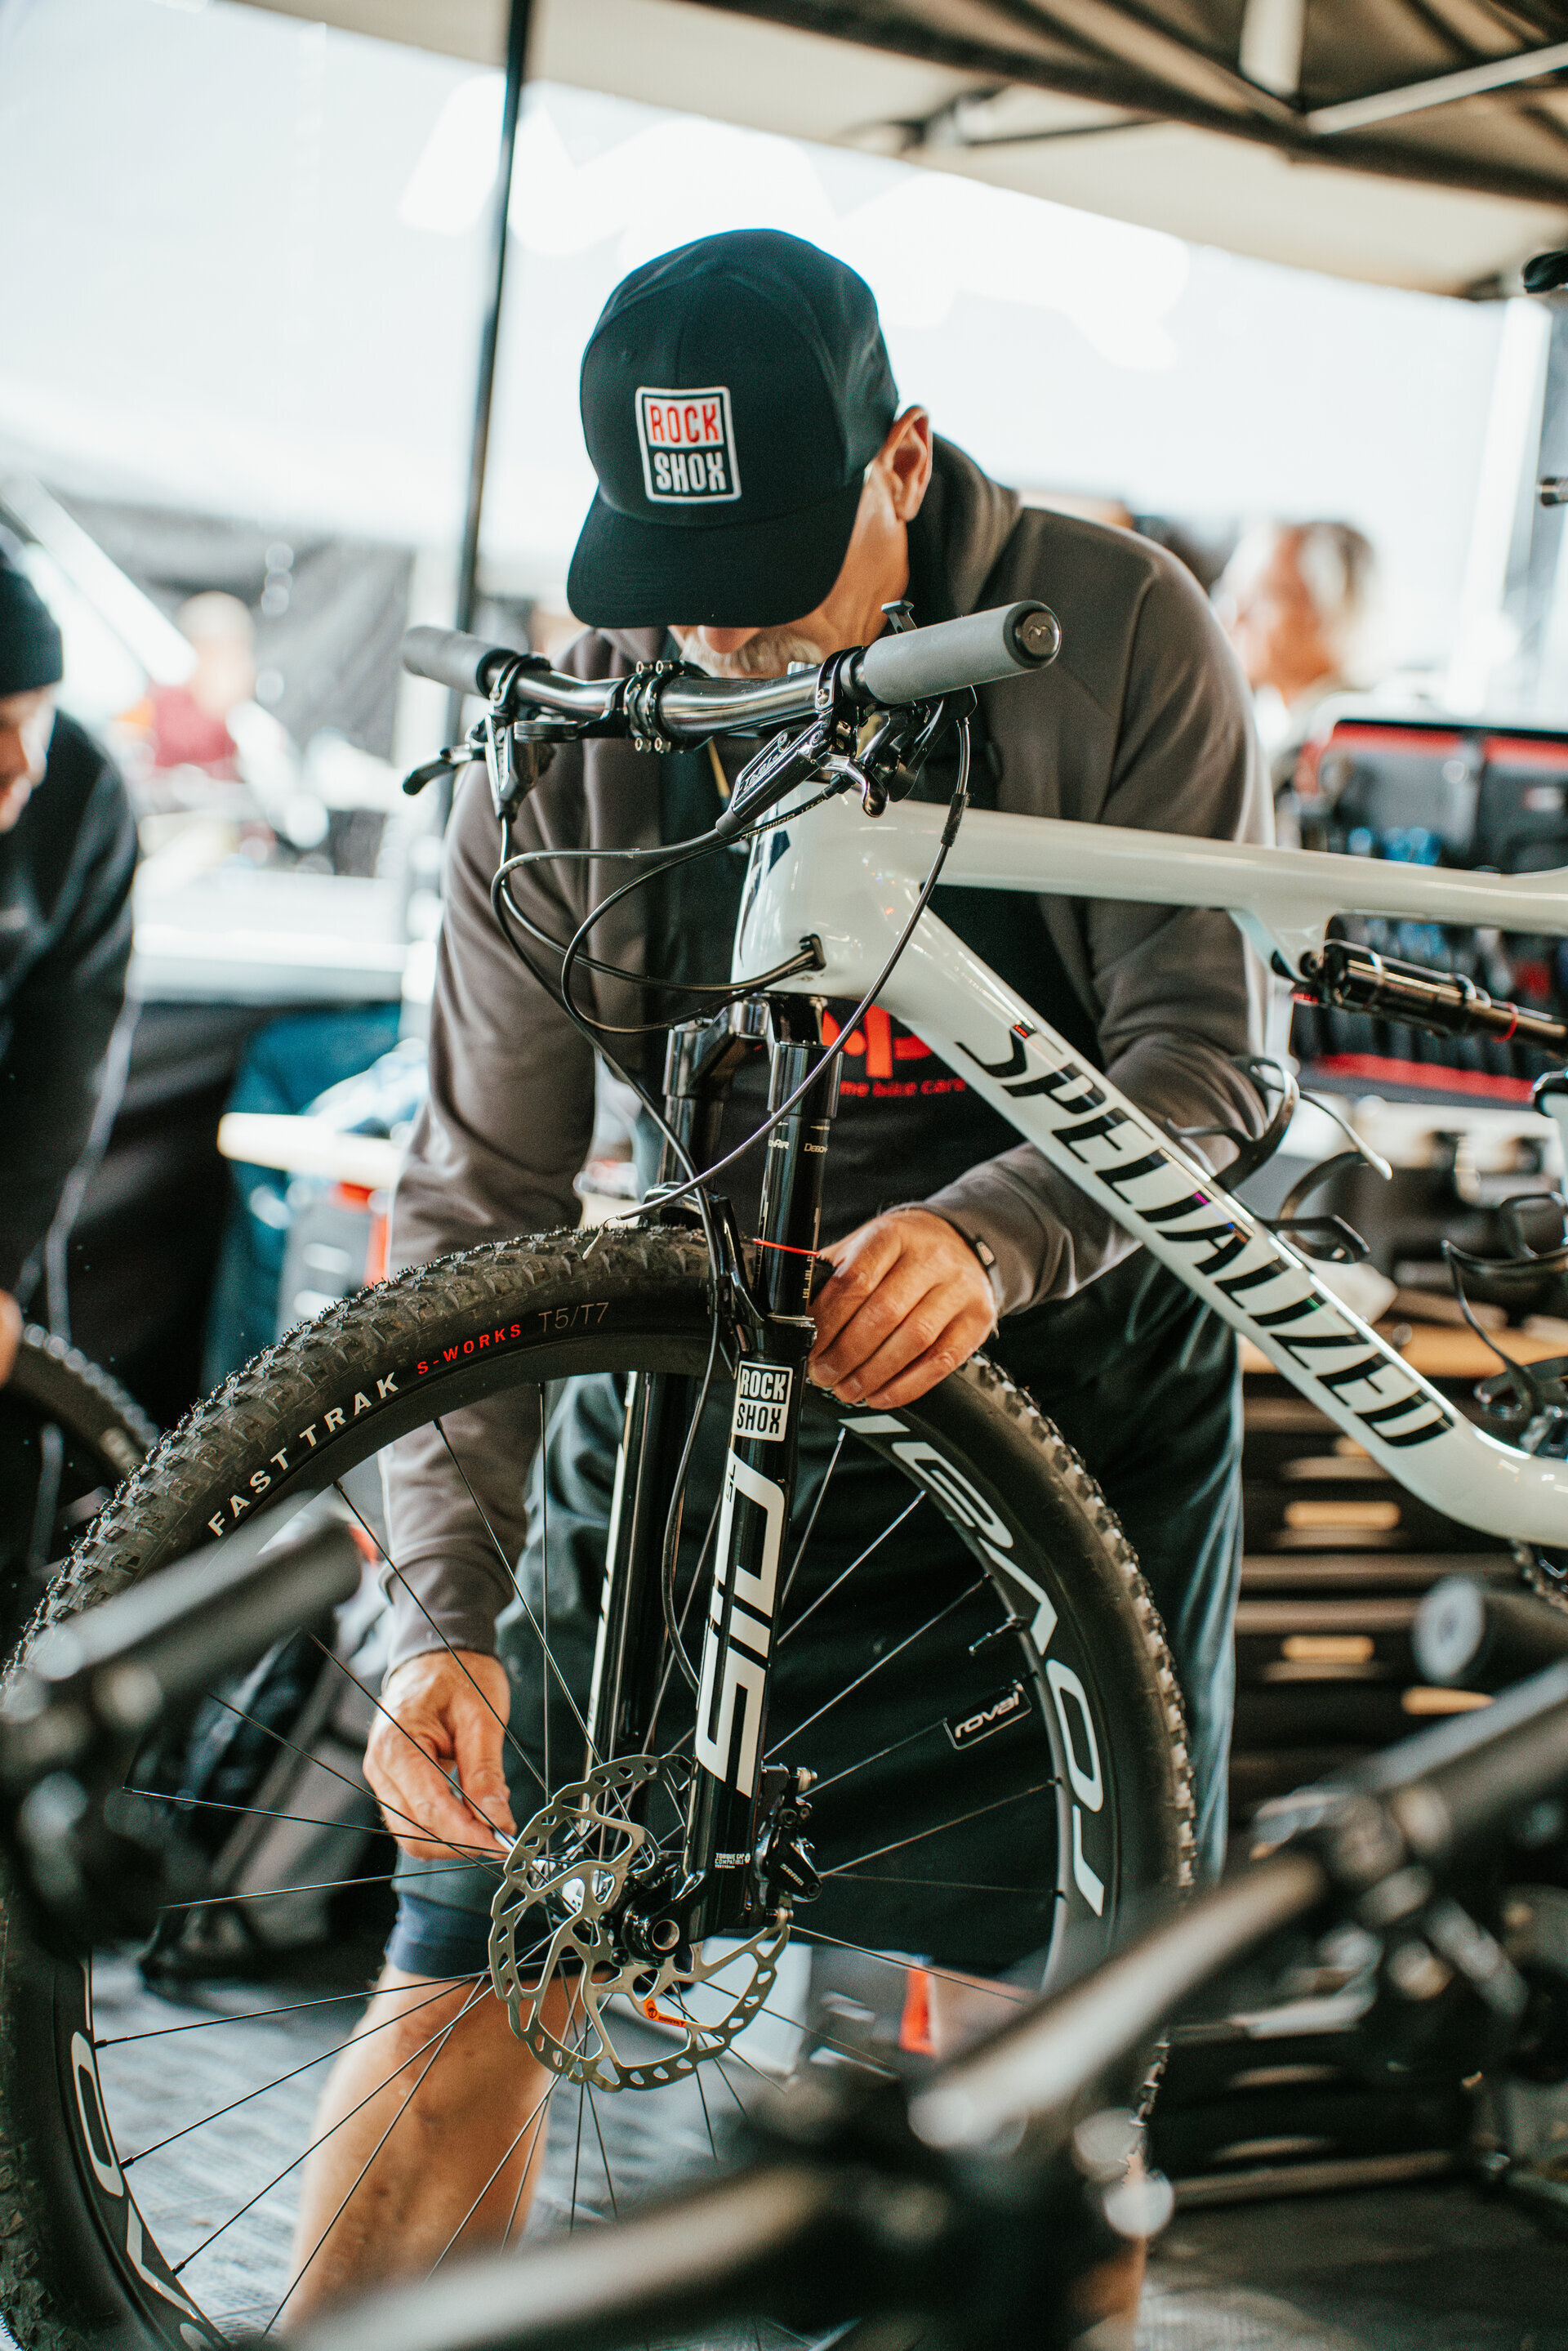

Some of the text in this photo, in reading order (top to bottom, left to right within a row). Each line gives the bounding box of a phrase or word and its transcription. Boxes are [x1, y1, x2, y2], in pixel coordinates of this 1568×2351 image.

[650, 404, 719, 444] ROCK
[653, 451, 727, 493] SHOX
[955, 1025, 1456, 1448] SPECIALIZED
[738, 1367, 788, 1403] ROCK
[207, 1302, 609, 1537] FAST TRAK S-WORKS T5/T7
[737, 1402, 782, 1435] SHOX
[695, 1447, 786, 1798] SID
[954, 1690, 1020, 1739] roval
[779, 1863, 805, 1887] SRAM
